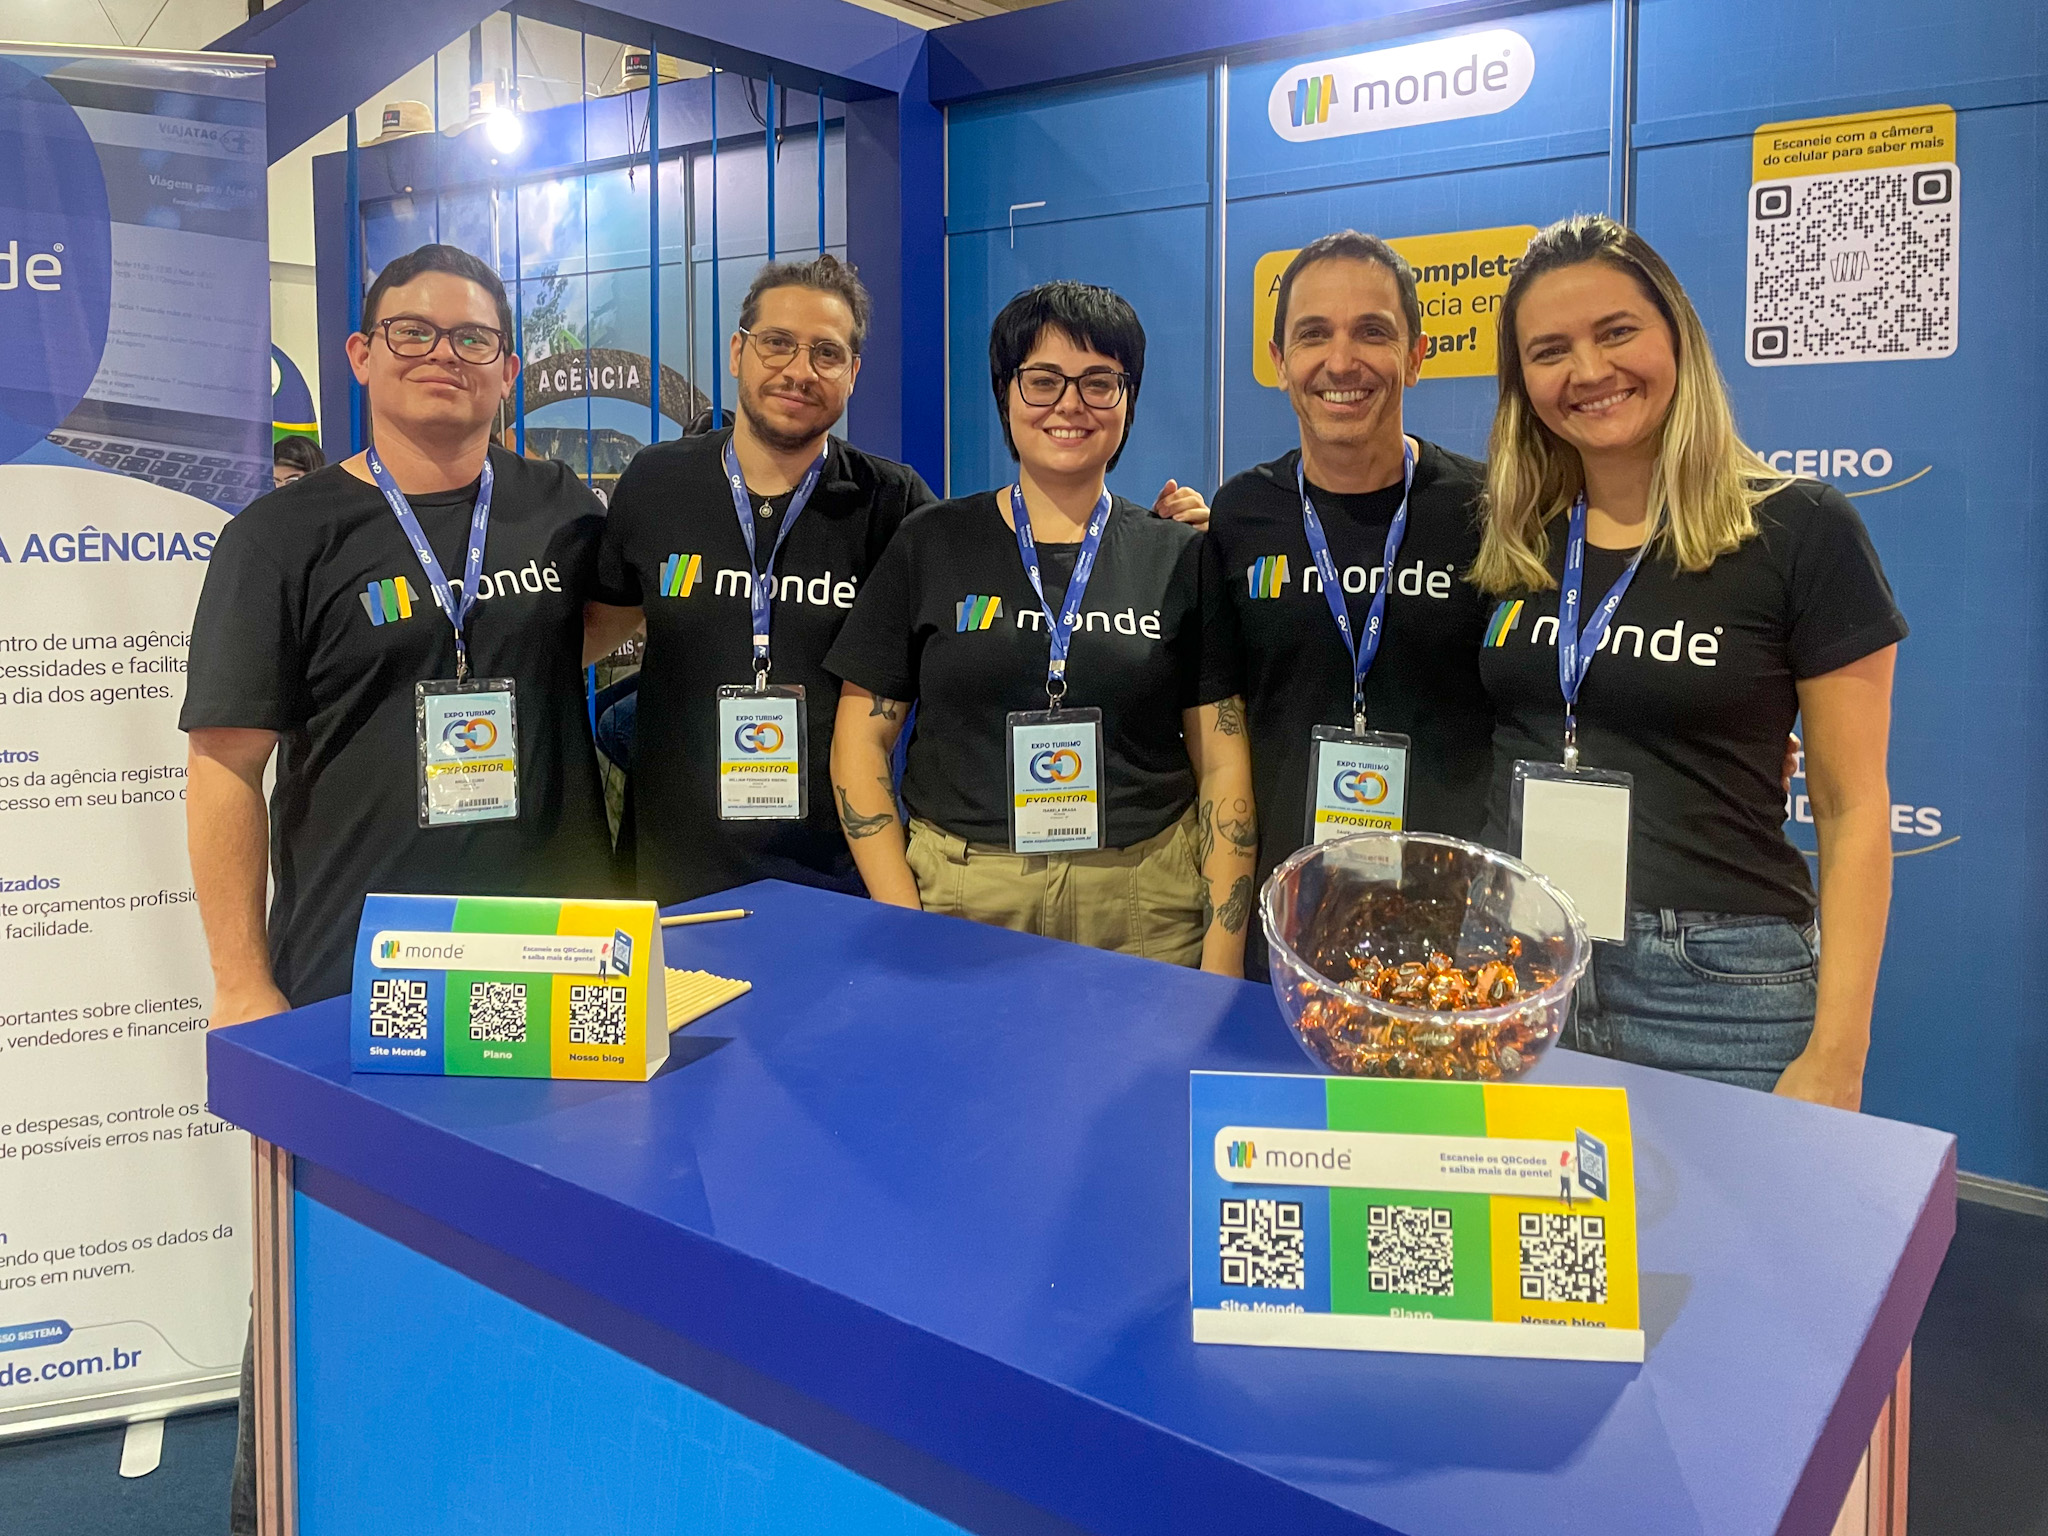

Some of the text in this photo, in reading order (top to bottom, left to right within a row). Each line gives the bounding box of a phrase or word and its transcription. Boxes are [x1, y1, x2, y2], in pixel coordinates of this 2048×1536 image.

[1773, 124, 1934, 151] Escaneie com a câmera
[1763, 136, 1944, 167] do celular para saber mais
[149, 174, 194, 191] Viagem
[1414, 253, 1521, 287] ompleta
[538, 357, 641, 393] AGÊNCIA
[1757, 447, 1893, 479] CEIRO
[20, 525, 217, 563] AGÊNCIAS
[43, 633, 67, 651] de
[72, 636, 117, 650] uma
[112, 661, 124, 675] e
[128, 655, 188, 675] facilita
[13, 685, 43, 704] dia
[48, 684, 84, 703] dos
[90, 680, 174, 705] agentes.
[444, 711, 463, 719] EXPO
[1031, 741, 1051, 750] EXPO
[1336, 760, 1357, 769] EXPO
[24, 771, 45, 787] da
[50, 767, 117, 790] agência
[55, 794, 82, 808] em
[87, 793, 117, 807] seu
[122, 788, 175, 805] banco
[1326, 814, 1392, 830] EXPOSITOR
[0, 875, 60, 893] izados
[22, 894, 126, 919] orçamentos
[6, 919, 93, 940] facilidade.
[563, 946, 593, 954] QRCodes
[83, 1001, 131, 1019] sobre
[134, 996, 203, 1016] clientes,
[8, 1016, 209, 1050] vendedores e financeiro
[369, 1046, 427, 1058] Site Monde
[483, 1050, 513, 1060] Plano
[569, 1053, 625, 1065] Nosso blog
[1, 1123, 12, 1136] e
[16, 1114, 103, 1135] despesas,
[106, 1103, 174, 1125] controle
[178, 1104, 199, 1117] os
[21, 1134, 101, 1161] possíveis
[106, 1130, 149, 1148] erros
[153, 1127, 183, 1142] nas
[187, 1119, 241, 1139] fatura
[1440, 1152, 1547, 1166] Escaneie os QRCodes
[1449, 1164, 1475, 1175] saiba
[1478, 1166, 1502, 1176] mais
[1505, 1167, 1517, 1177] da
[1519, 1169, 1552, 1179] gente!
[43, 1248, 75, 1266] que
[79, 1240, 128, 1258] todos
[132, 1236, 152, 1250] os
[157, 1229, 208, 1247] dados
[213, 1224, 233, 1240] da
[41, 1271, 68, 1286] em
[73, 1264, 135, 1282] nuvem.
[1220, 1299, 1305, 1314] Site Monde
[18, 1326, 63, 1341] SISTEMA
